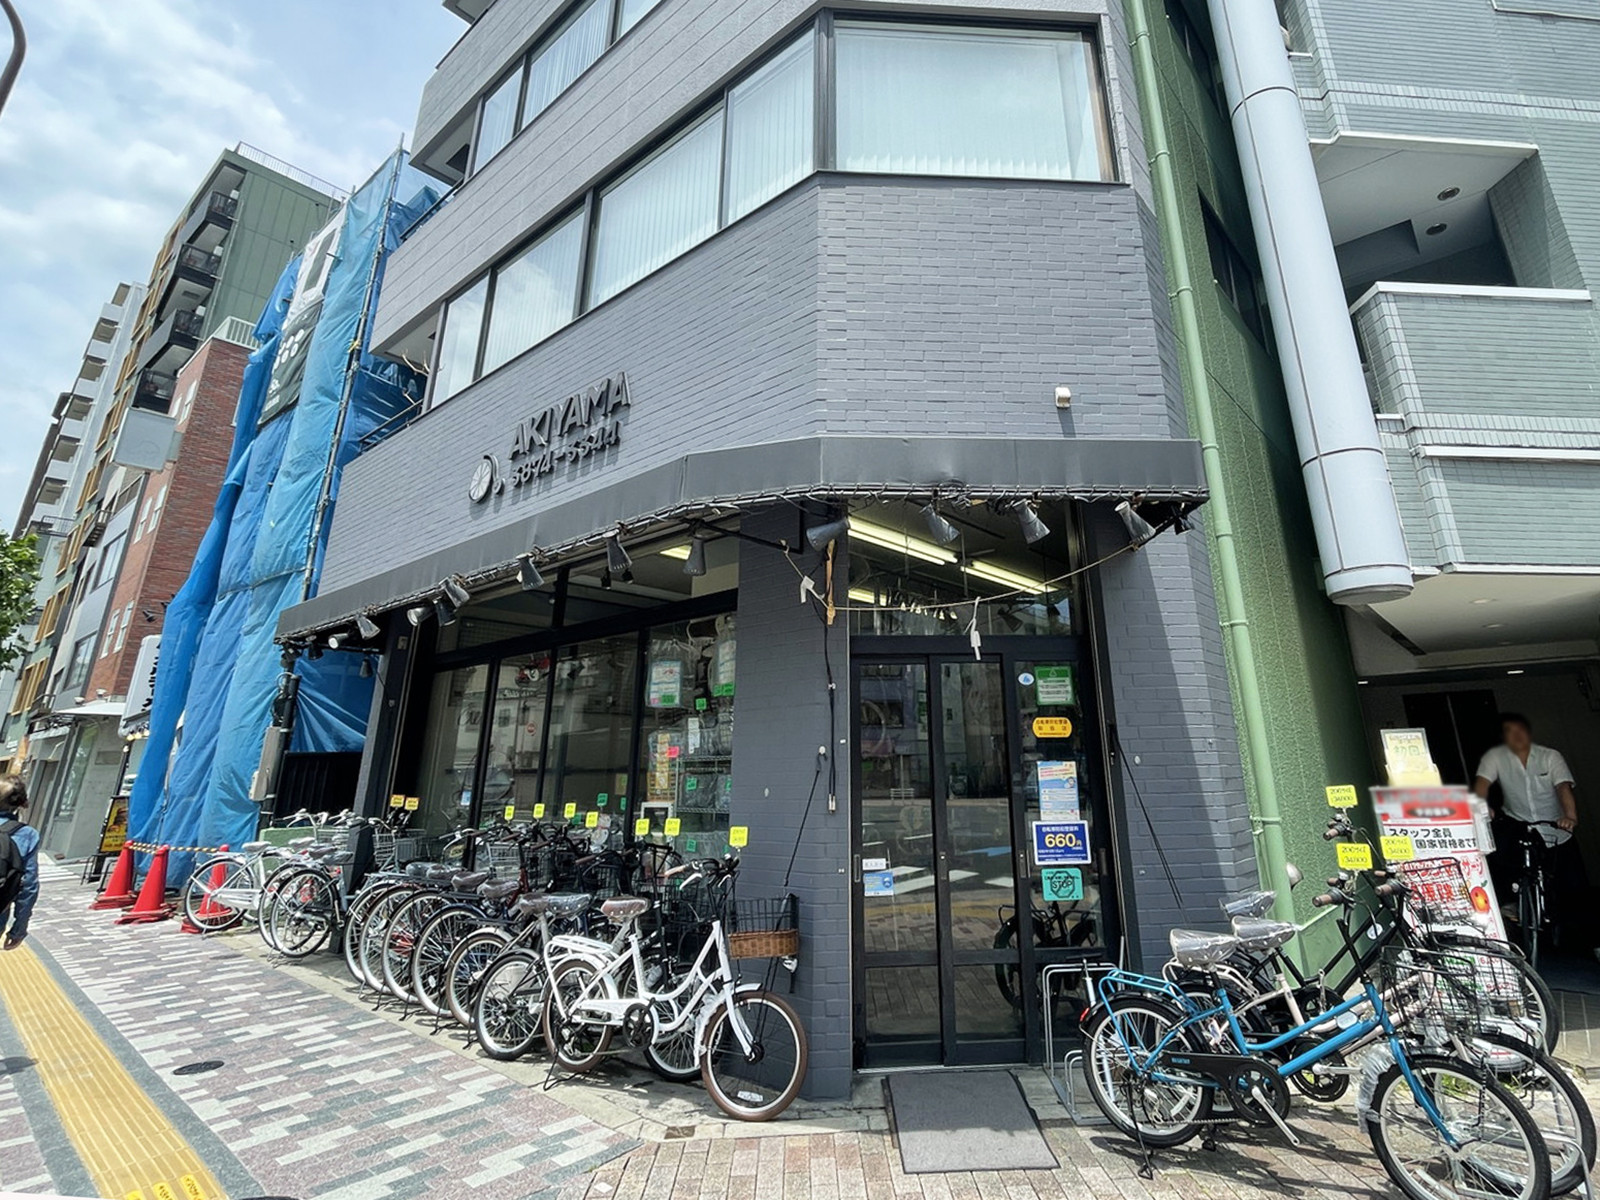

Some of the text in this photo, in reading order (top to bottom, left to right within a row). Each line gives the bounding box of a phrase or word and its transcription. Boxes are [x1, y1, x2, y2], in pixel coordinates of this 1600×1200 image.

[510, 371, 631, 461] AKIYAMA
[1389, 827, 1453, 839] スタッフ全員
[1052, 880, 1073, 889] STOP
